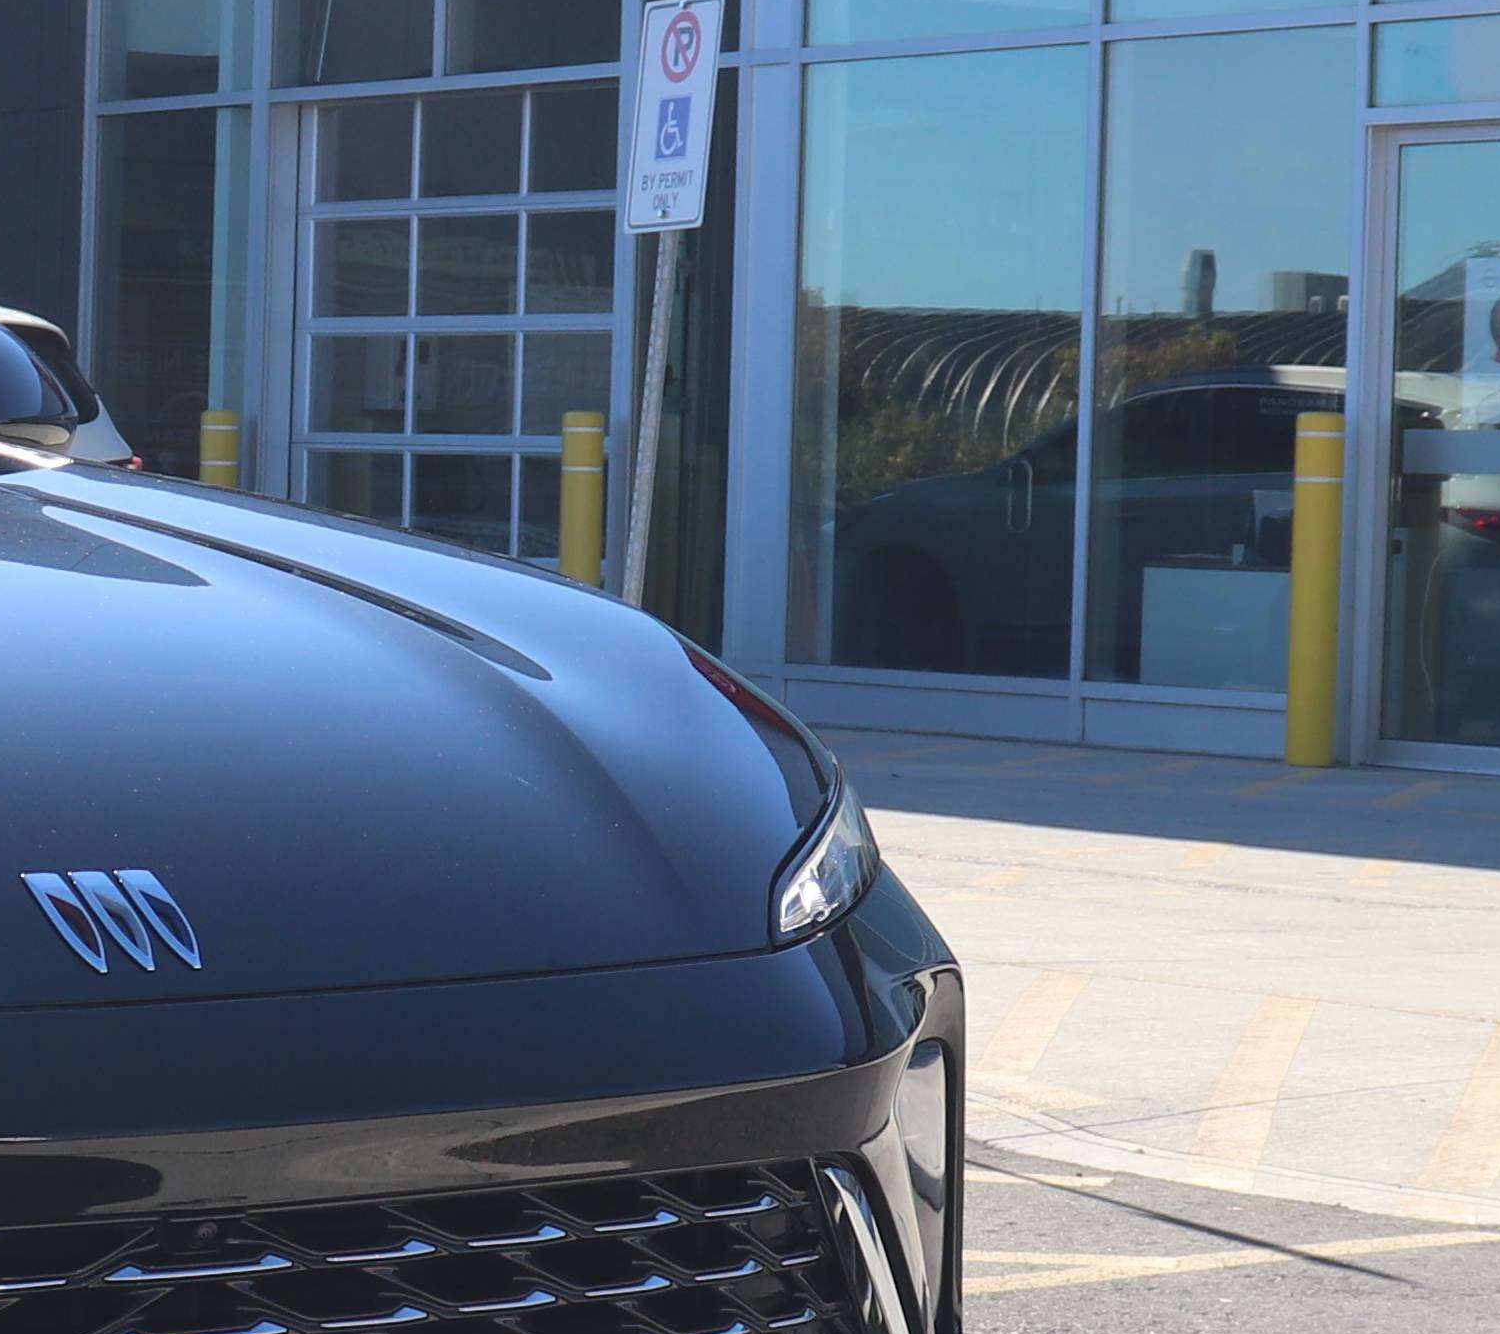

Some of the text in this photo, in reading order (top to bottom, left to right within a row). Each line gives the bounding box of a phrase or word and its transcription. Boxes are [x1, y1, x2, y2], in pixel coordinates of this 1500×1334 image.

[641, 169, 695, 191] BY PERMIT
[653, 192, 679, 211] ONLY
